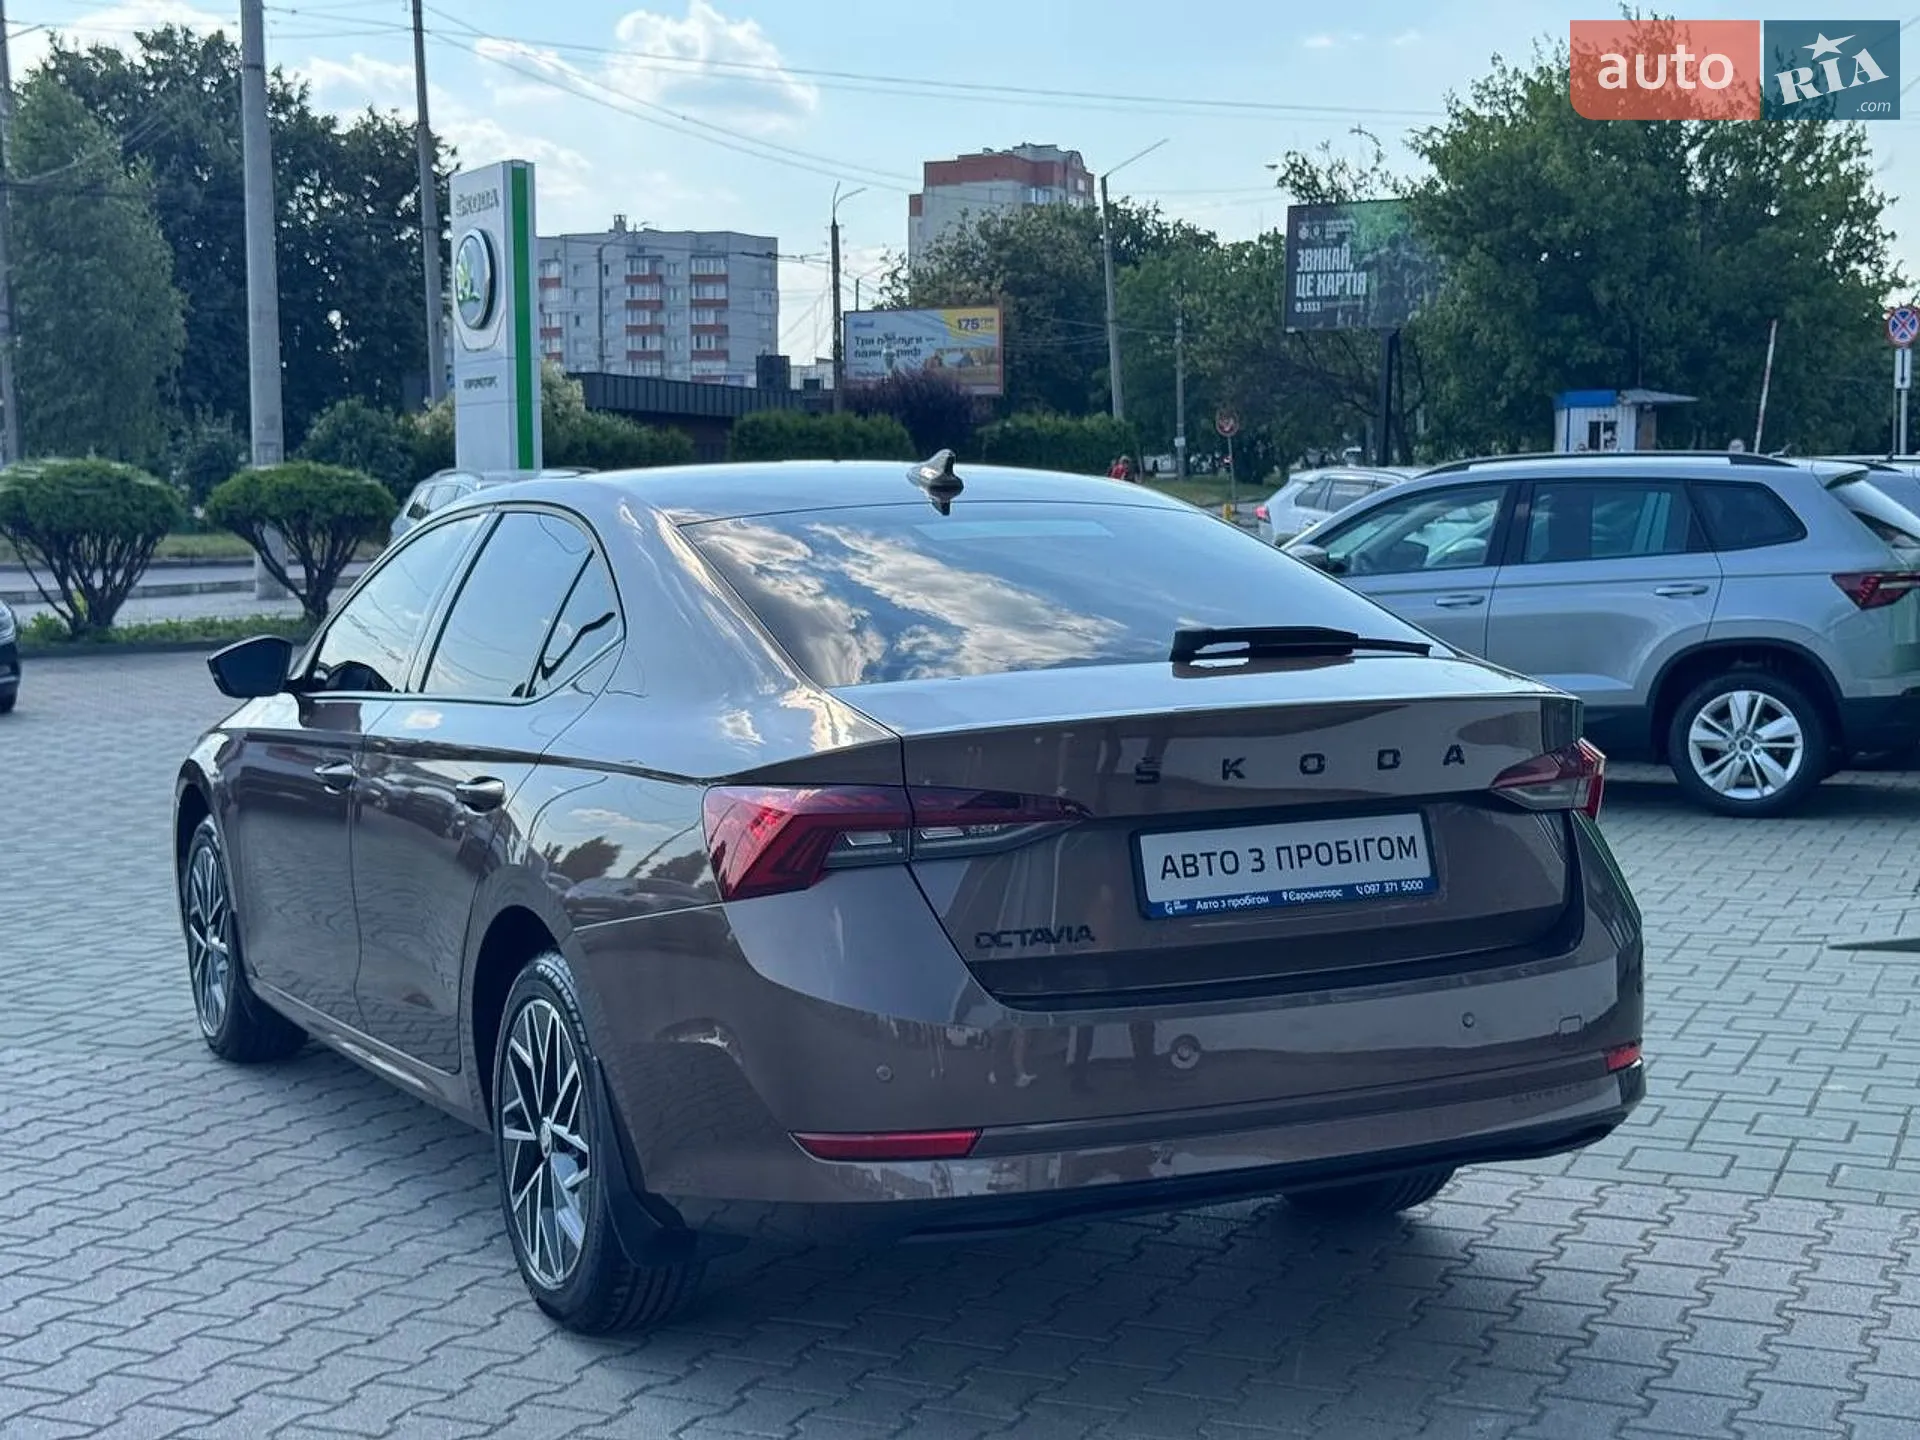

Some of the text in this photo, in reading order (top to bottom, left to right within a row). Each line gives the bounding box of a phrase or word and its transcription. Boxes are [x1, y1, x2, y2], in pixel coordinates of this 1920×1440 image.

[1296, 273, 1314, 299] ЦЕ
[1161, 834, 1418, 880] АВТО З ПРОБІГОМ
[1364, 880, 1424, 895] 097 371 5000
[1195, 900, 1219, 910] Авто
[1227, 895, 1269, 909] пробігом
[974, 924, 1096, 949] OCTAVIA
